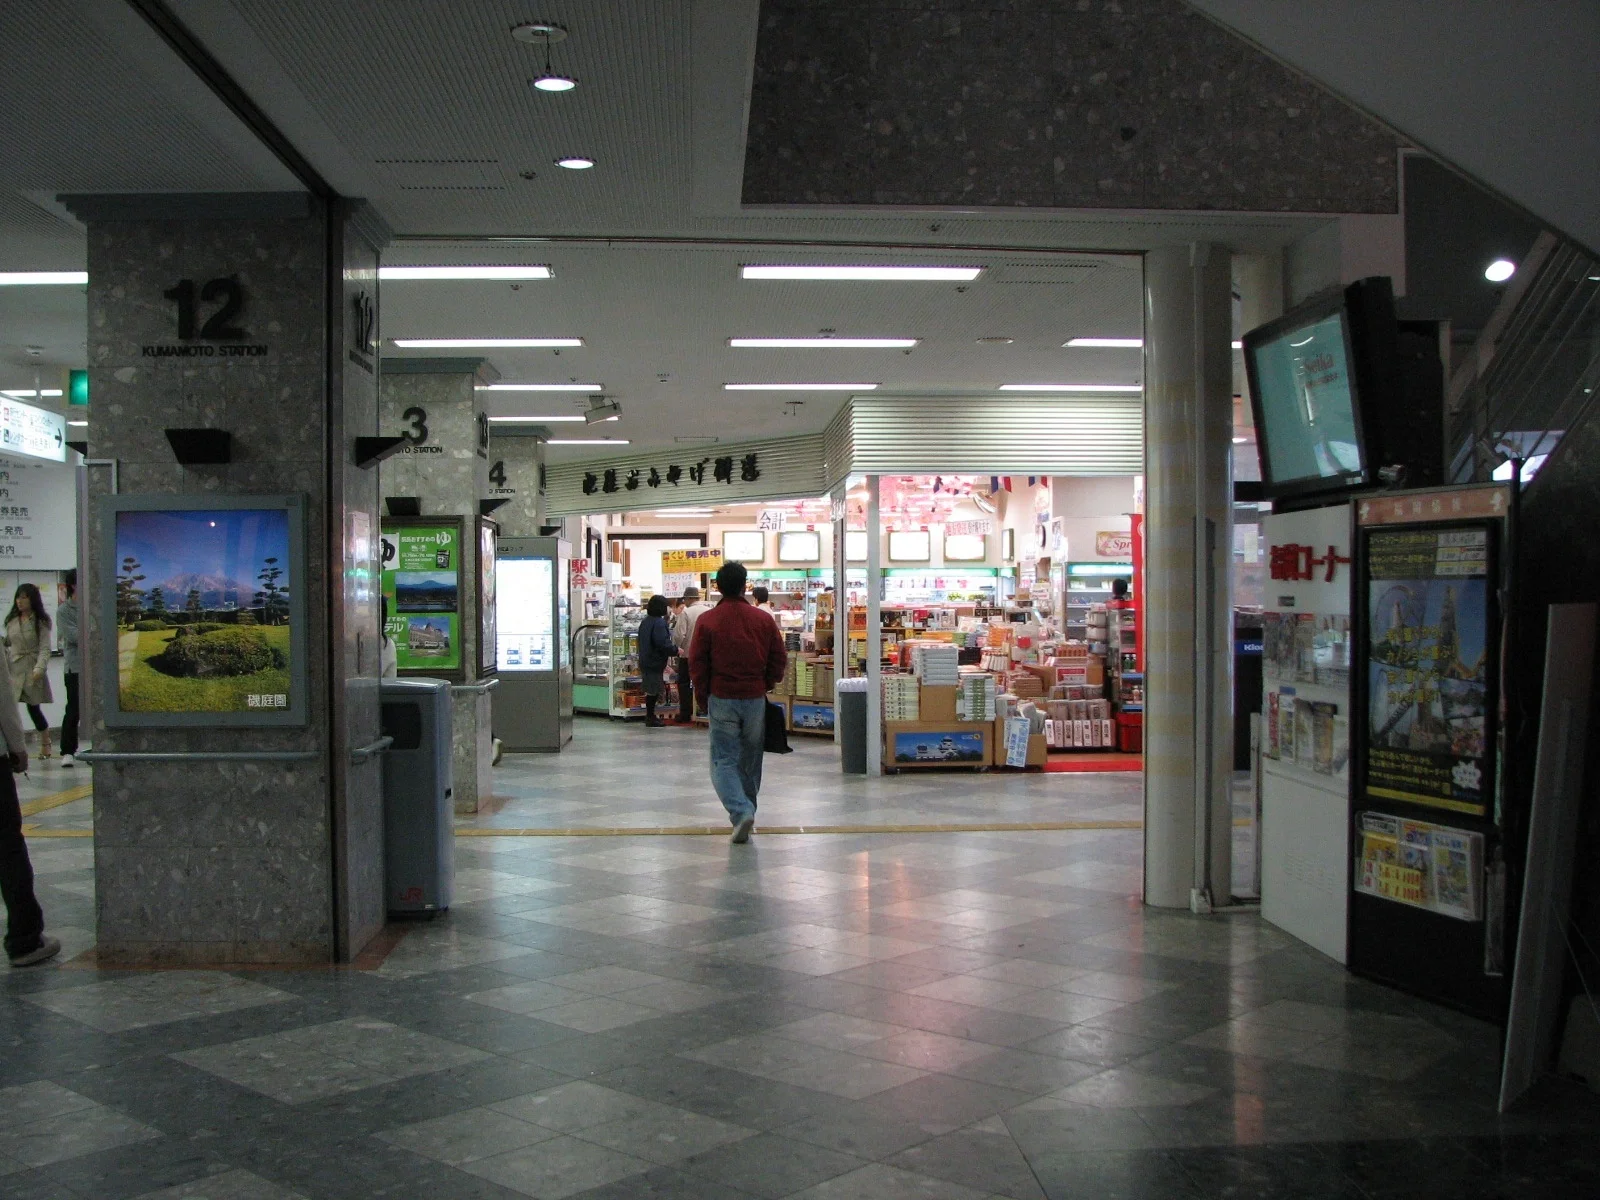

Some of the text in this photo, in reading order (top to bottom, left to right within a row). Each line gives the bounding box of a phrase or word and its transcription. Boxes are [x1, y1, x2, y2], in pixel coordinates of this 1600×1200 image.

[163, 277, 245, 340] 12
[142, 345, 269, 357] KUMAMOTO STATION
[402, 406, 429, 446] 3
[413, 445, 443, 454] STATION
[489, 461, 507, 487] 4
[759, 511, 786, 531] 会計
[572, 558, 589, 590] 駅弁
[247, 693, 287, 708] 磯庭園
